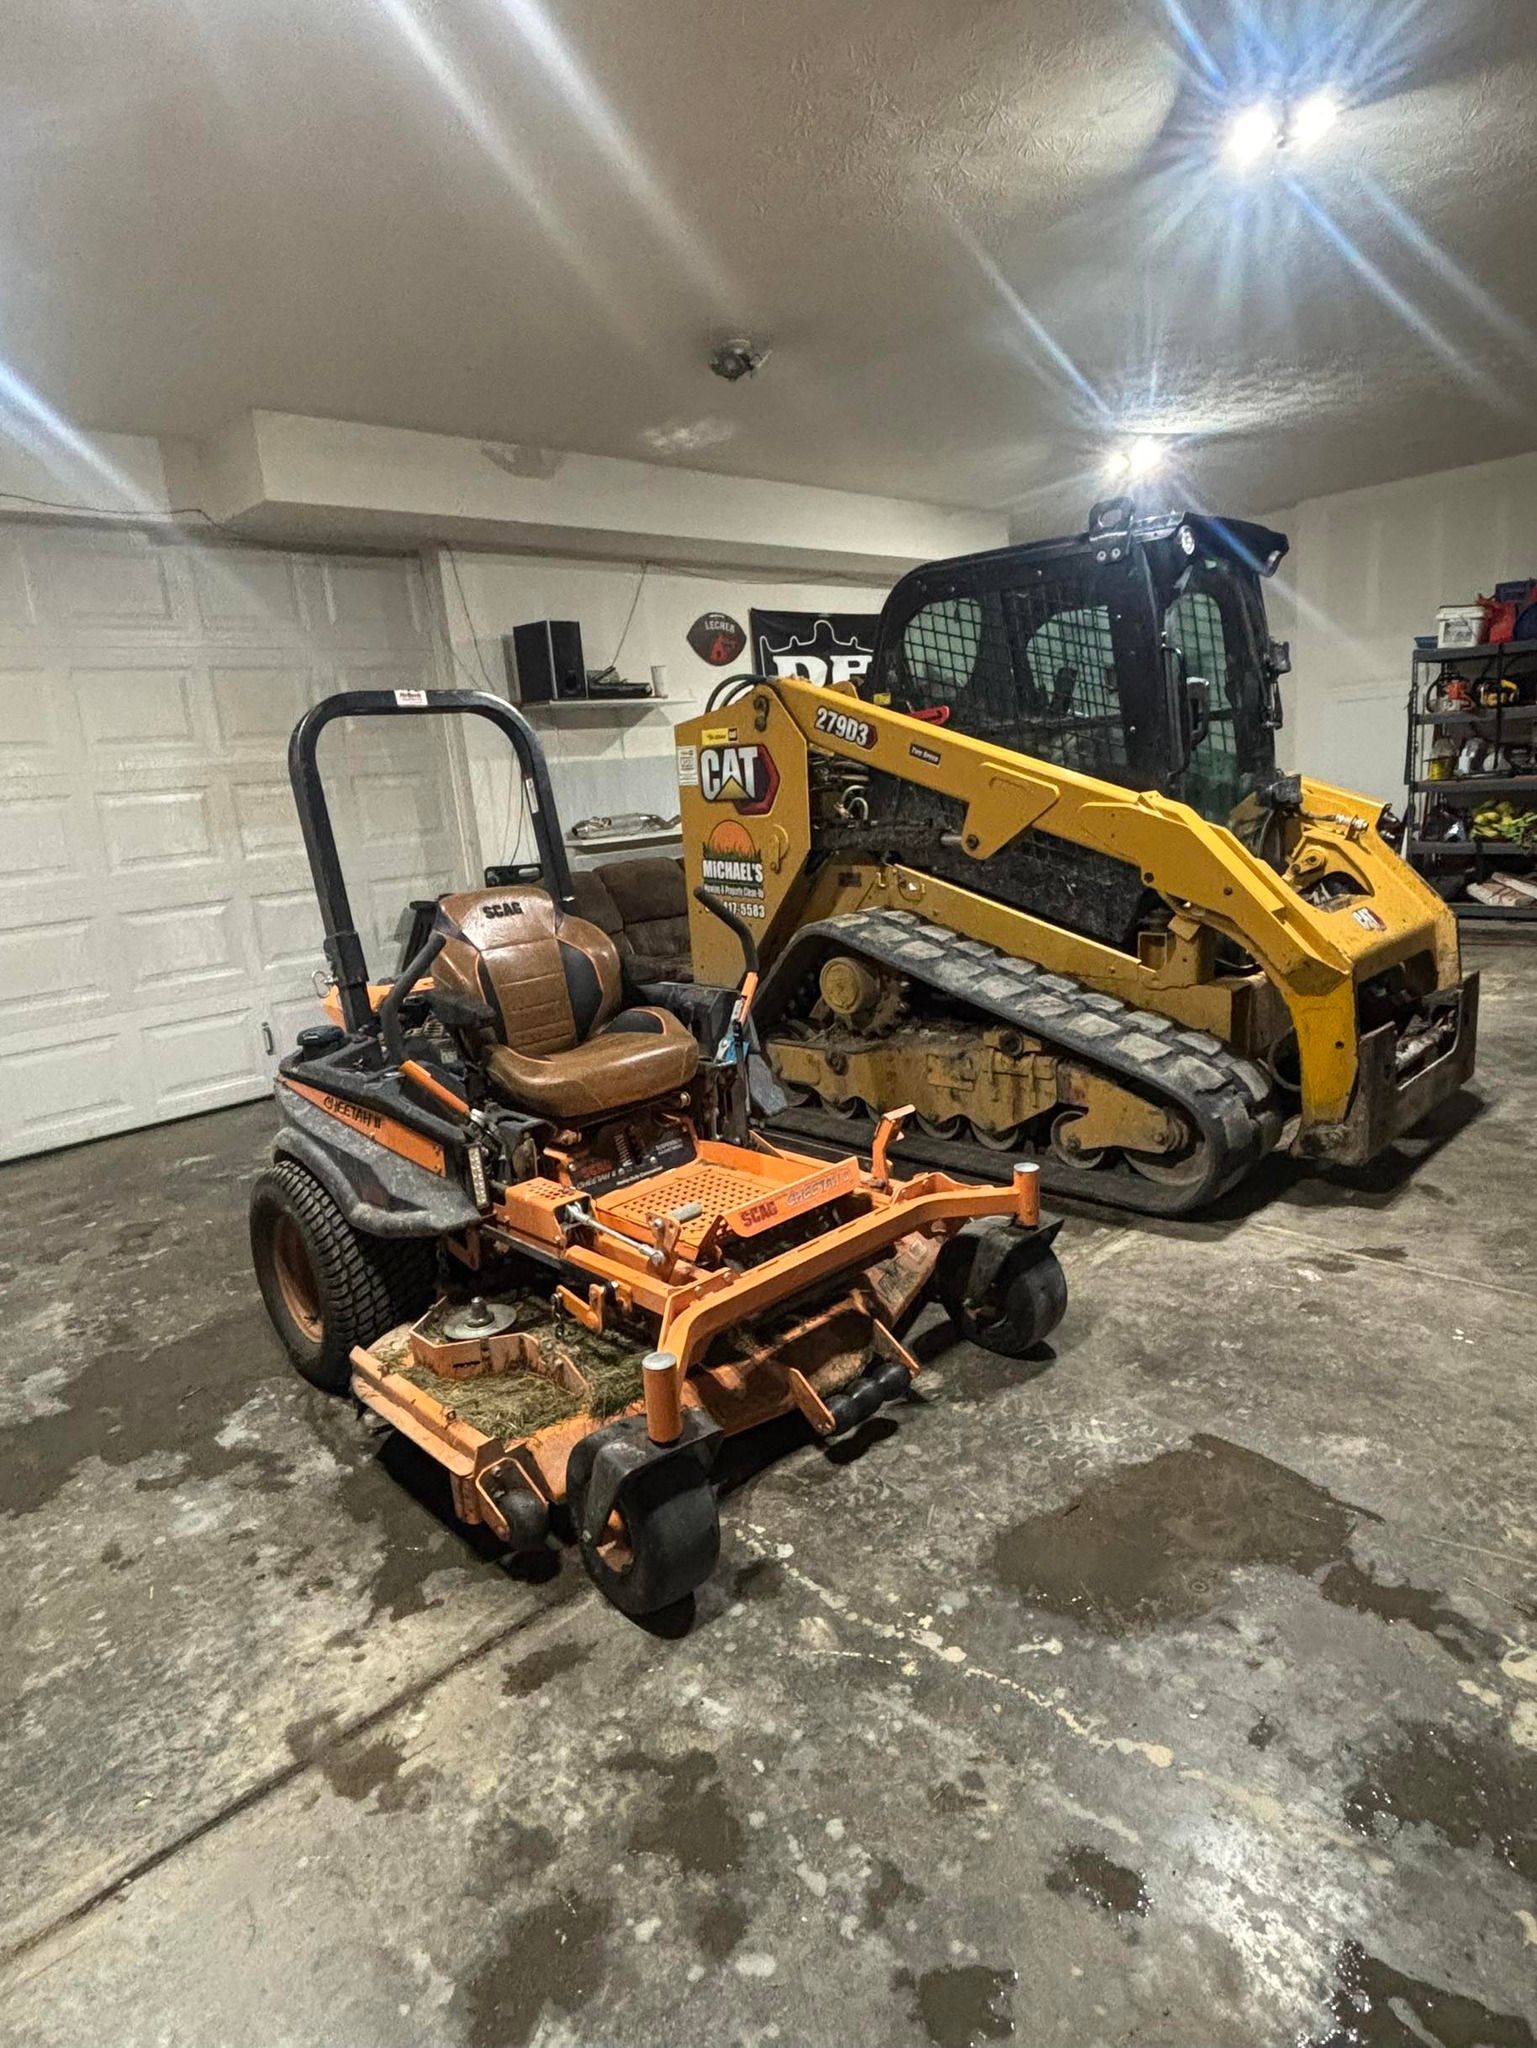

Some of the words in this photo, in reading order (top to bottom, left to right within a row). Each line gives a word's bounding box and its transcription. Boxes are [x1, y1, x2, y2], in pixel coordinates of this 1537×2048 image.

[815, 707, 869, 746] 279D3
[700, 746, 758, 801] CAT
[482, 901, 524, 920] SCAG
[740, 1201, 778, 1227] SCAG
